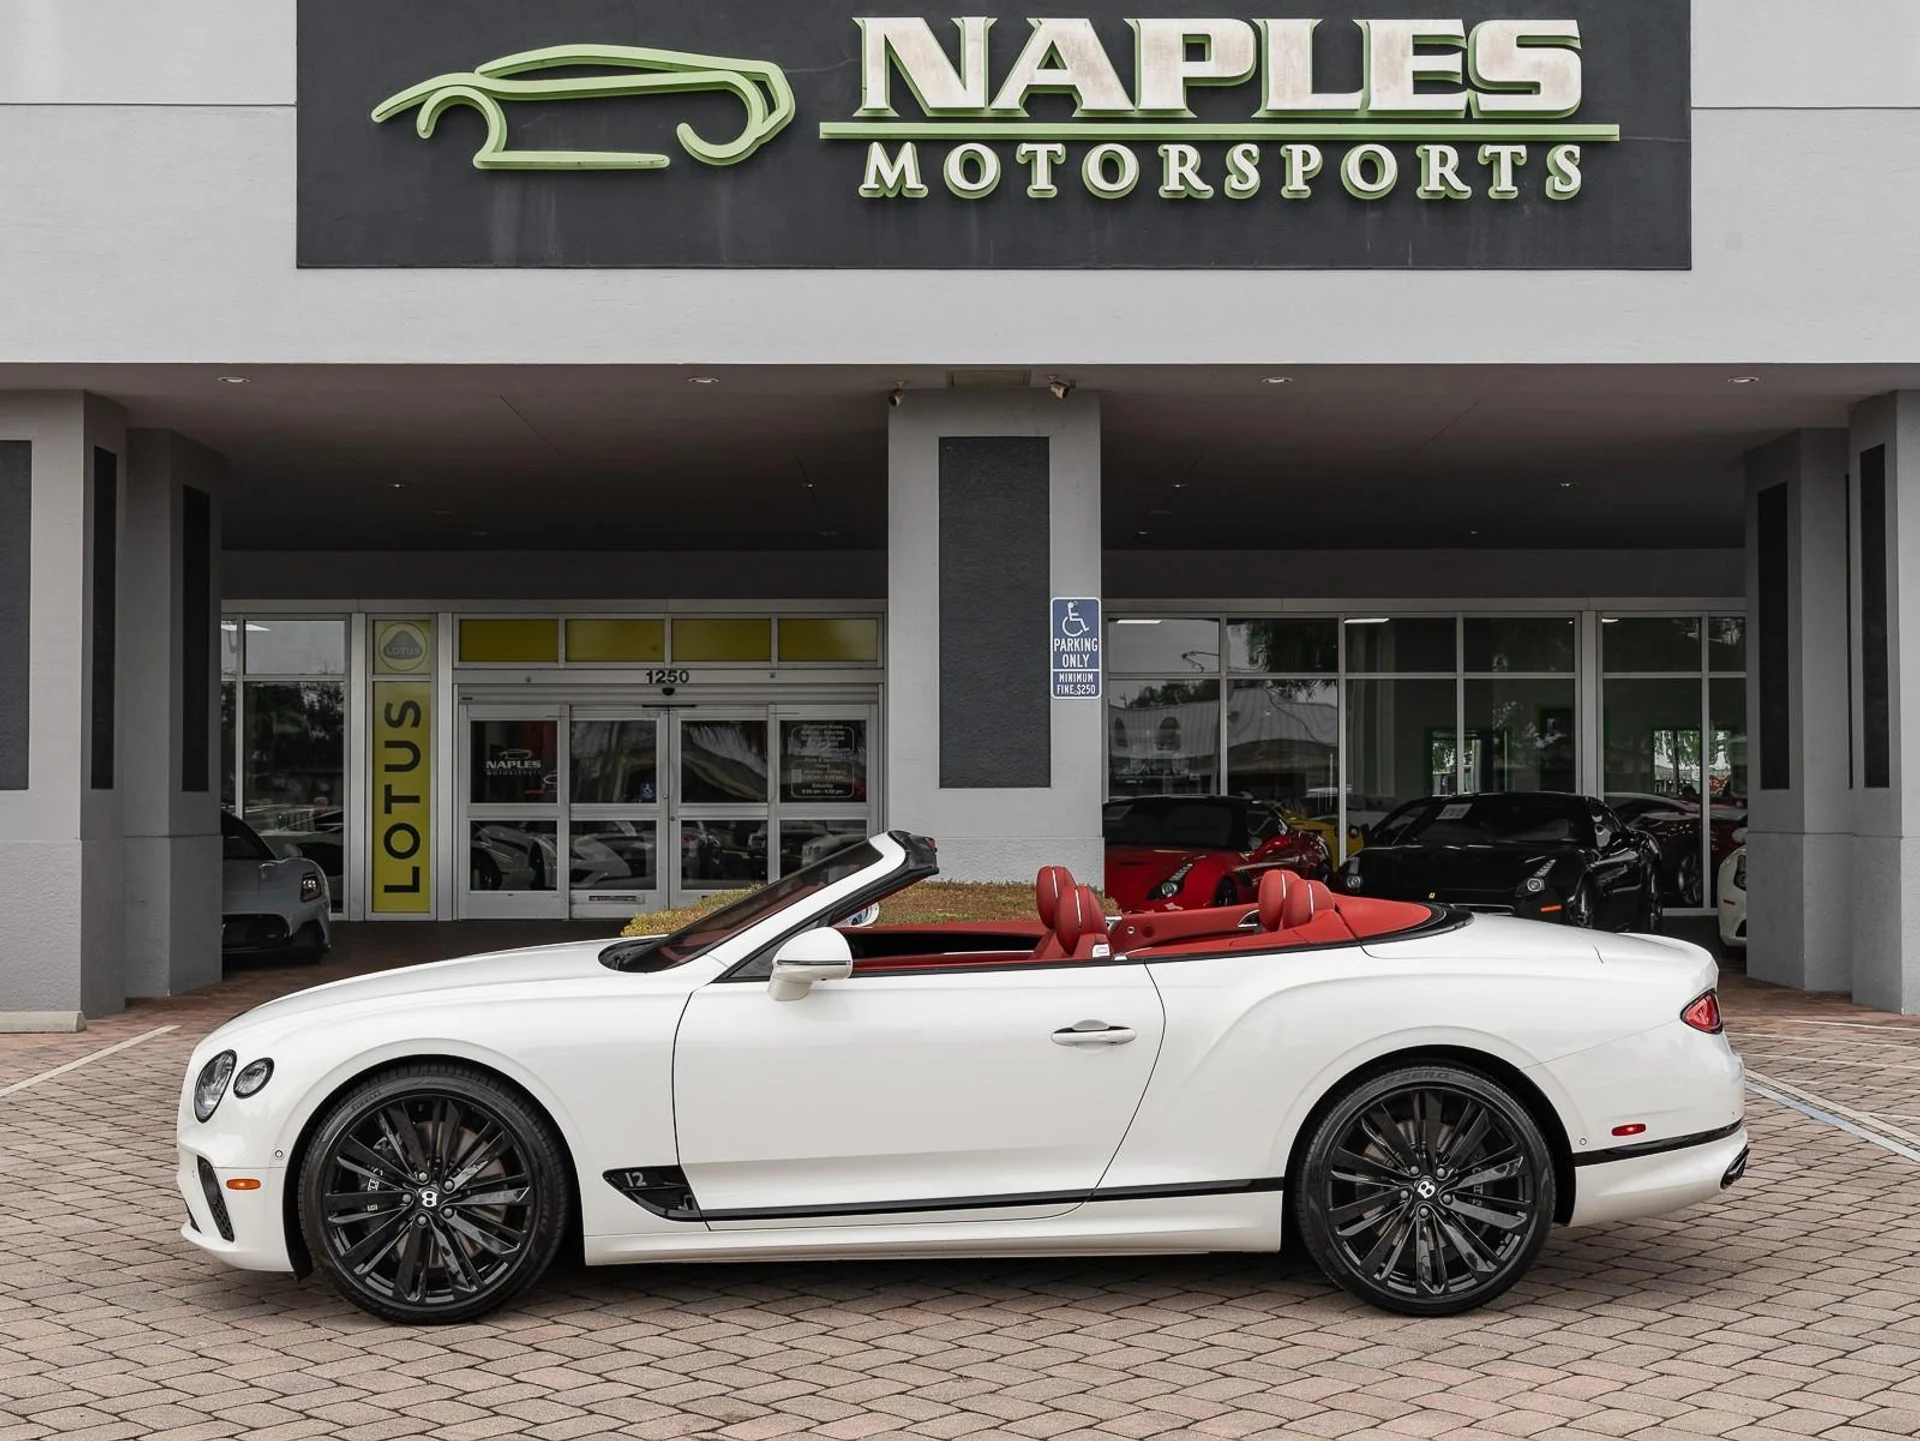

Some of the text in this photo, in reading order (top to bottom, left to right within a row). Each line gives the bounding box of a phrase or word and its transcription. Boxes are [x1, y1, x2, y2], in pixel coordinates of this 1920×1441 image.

[852, 17, 1581, 119] NAPLES
[858, 142, 1582, 200] MOTORSPORTS
[1053, 638, 1098, 652] PARKING
[1062, 654, 1089, 668] ONLY
[646, 670, 690, 684] 1250
[1059, 673, 1093, 683] MINIMUM
[1057, 685, 1096, 695] FINE $250
[486, 760, 541, 769] NAPLES
[384, 700, 421, 893] LOTUS
[625, 1172, 647, 1187] 12
